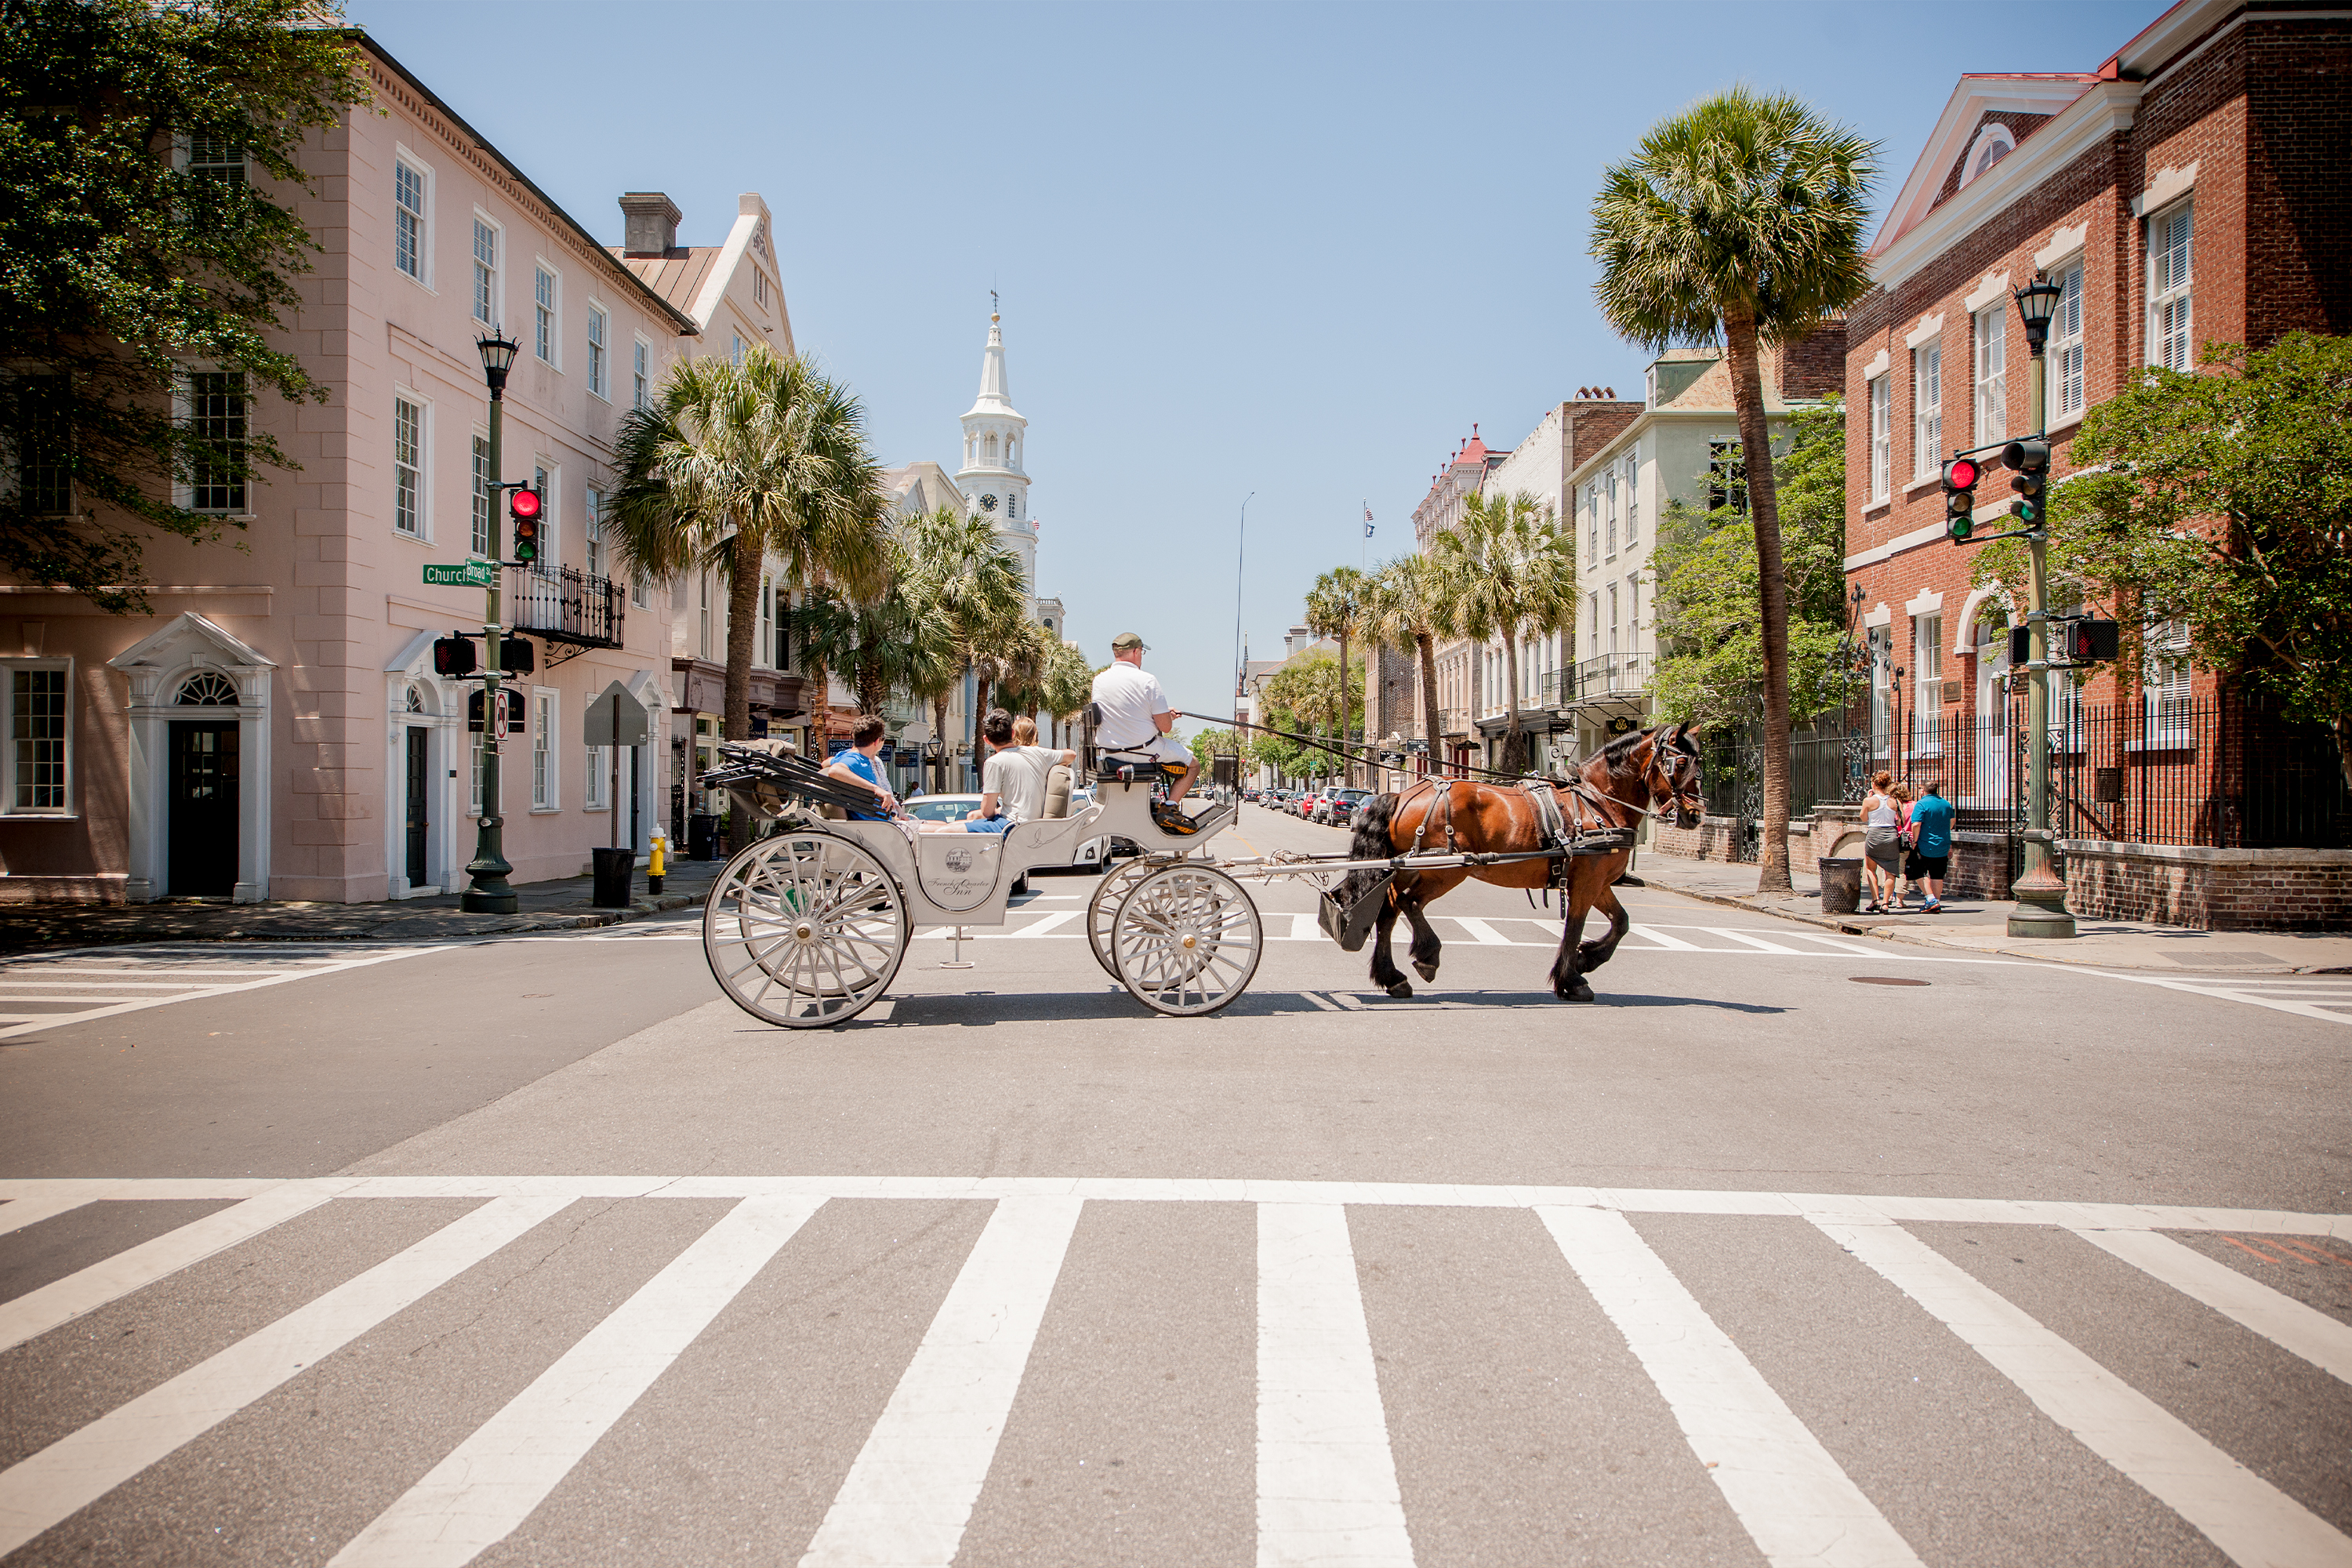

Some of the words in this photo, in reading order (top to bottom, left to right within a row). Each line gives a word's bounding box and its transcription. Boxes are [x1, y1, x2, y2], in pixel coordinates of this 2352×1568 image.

[466, 561, 485, 579] Broad
[927, 877, 954, 887] French
[960, 879, 989, 888] Quarter
[943, 880, 972, 895] Inn
